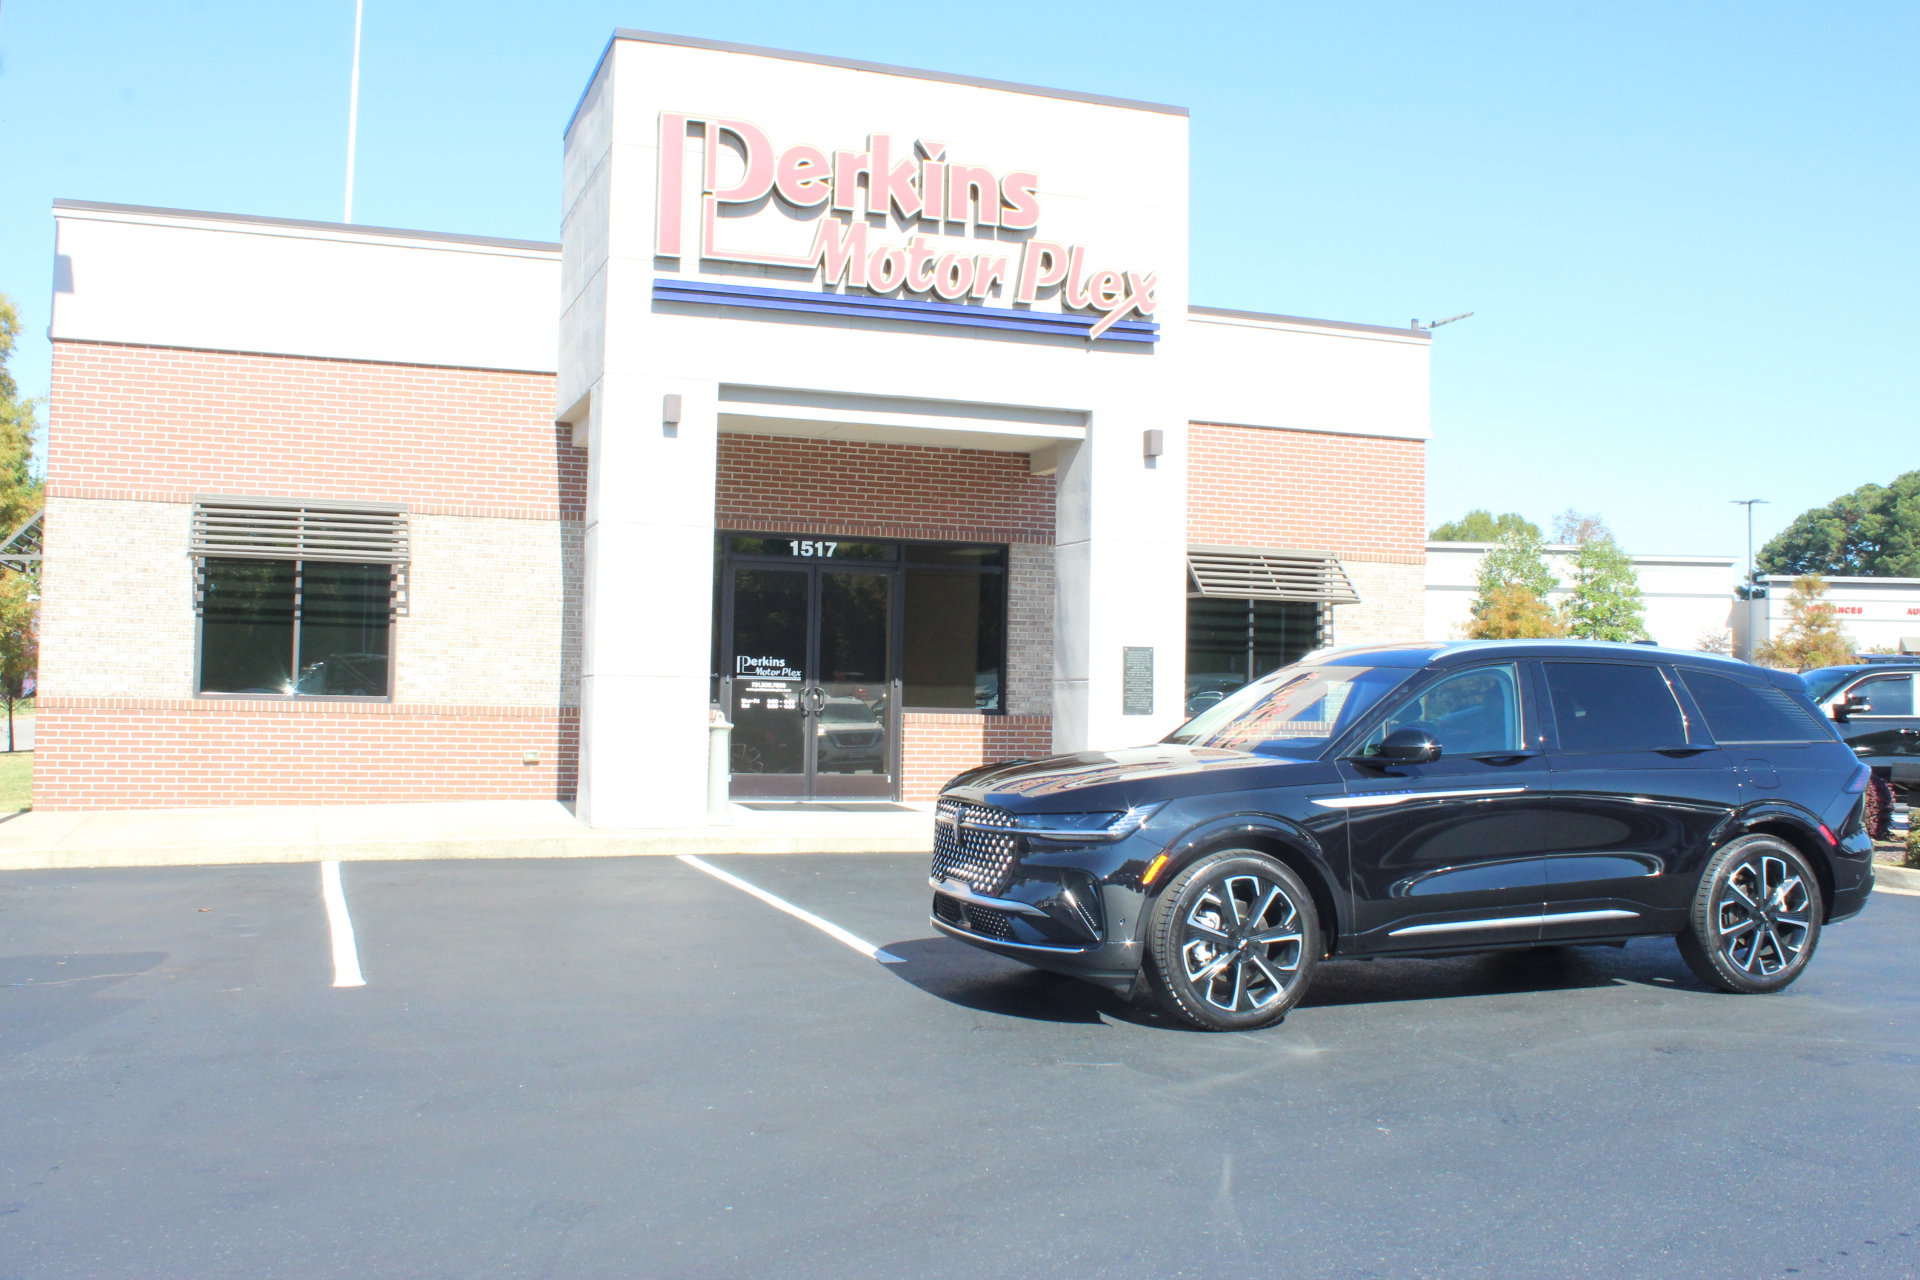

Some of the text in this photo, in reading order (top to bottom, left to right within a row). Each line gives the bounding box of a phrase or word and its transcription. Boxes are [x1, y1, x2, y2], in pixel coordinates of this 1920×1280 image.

[655, 110, 1040, 258] Perkins
[803, 217, 1158, 340] Motor Plex
[790, 540, 838, 558] 1517
[736, 655, 786, 673] Perkins
[755, 666, 802, 678] Motor Plex
